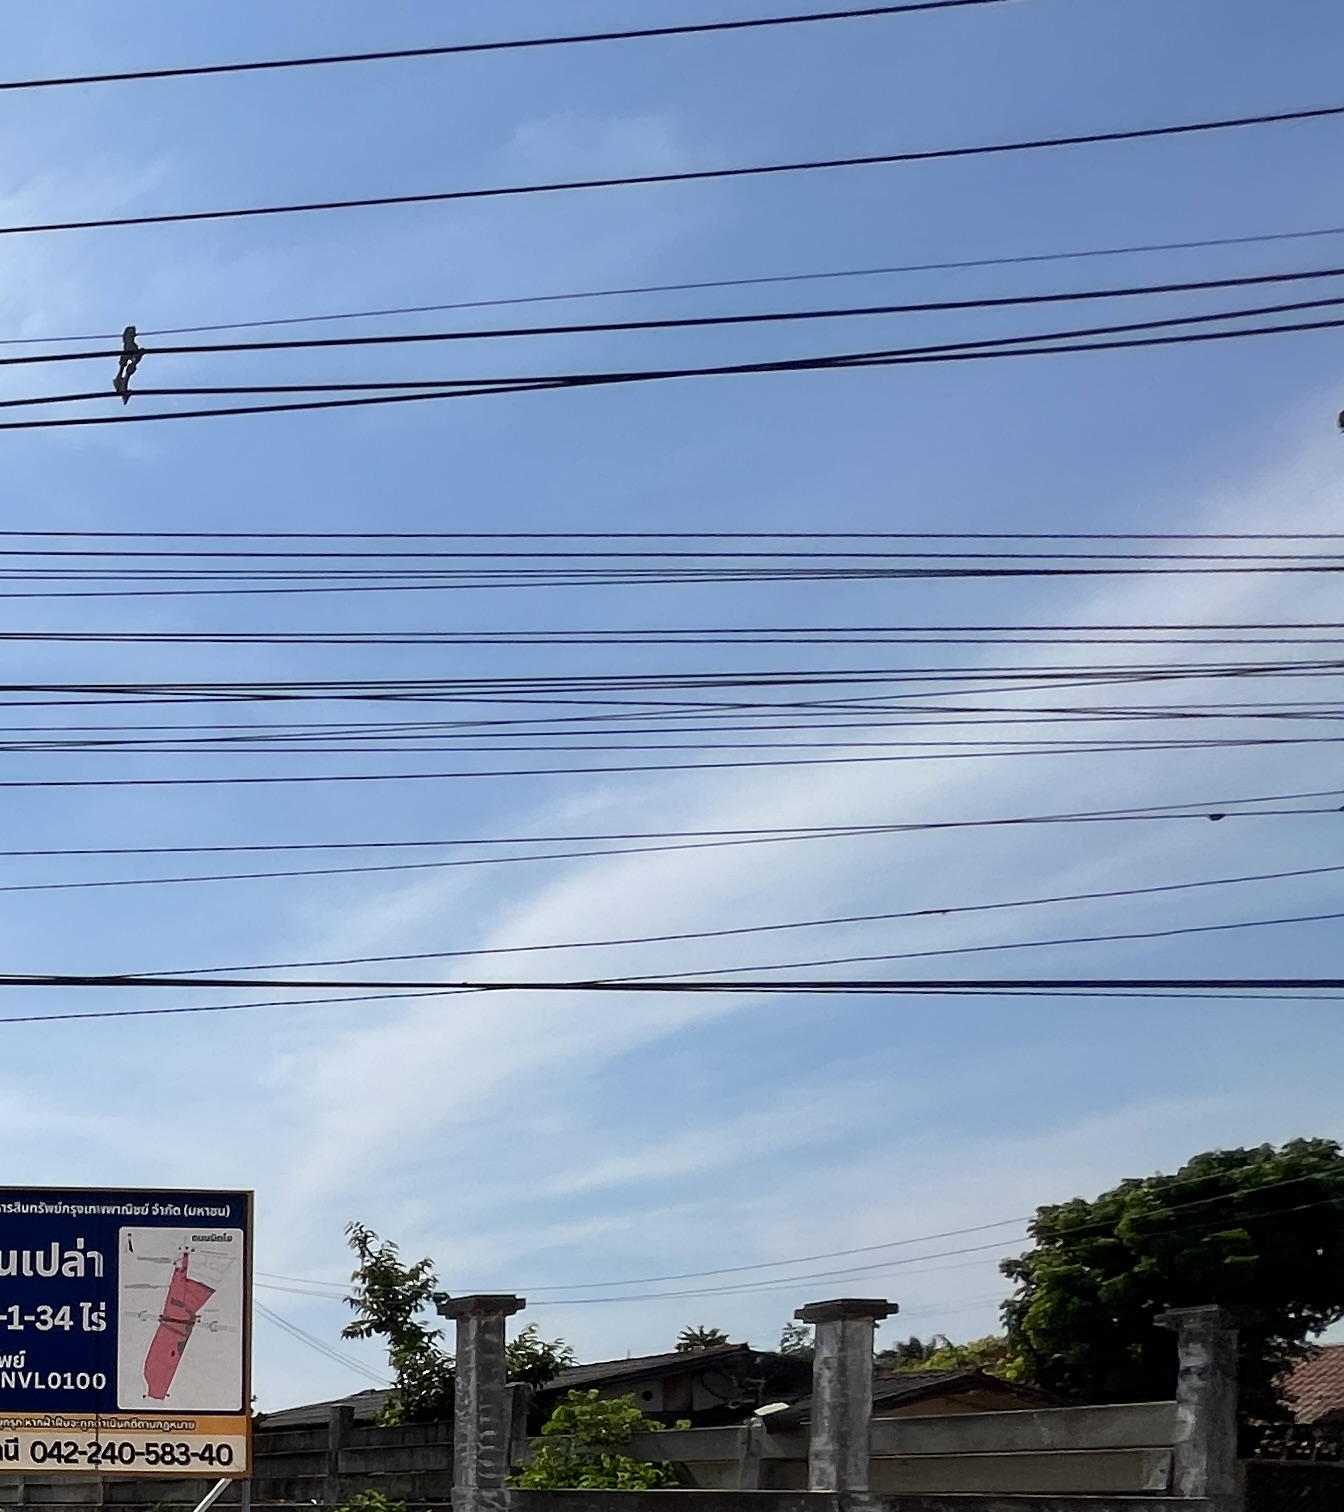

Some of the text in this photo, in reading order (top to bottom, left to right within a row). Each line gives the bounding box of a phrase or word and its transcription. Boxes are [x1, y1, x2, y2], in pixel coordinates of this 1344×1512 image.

[151, 1204, 181, 1216] จำกัด
[183, 1204, 231, 1218] (มหาชน)
[79, 1301, 107, 1332] ไร่
[30, 1440, 233, 1467] 042-240-583-40
